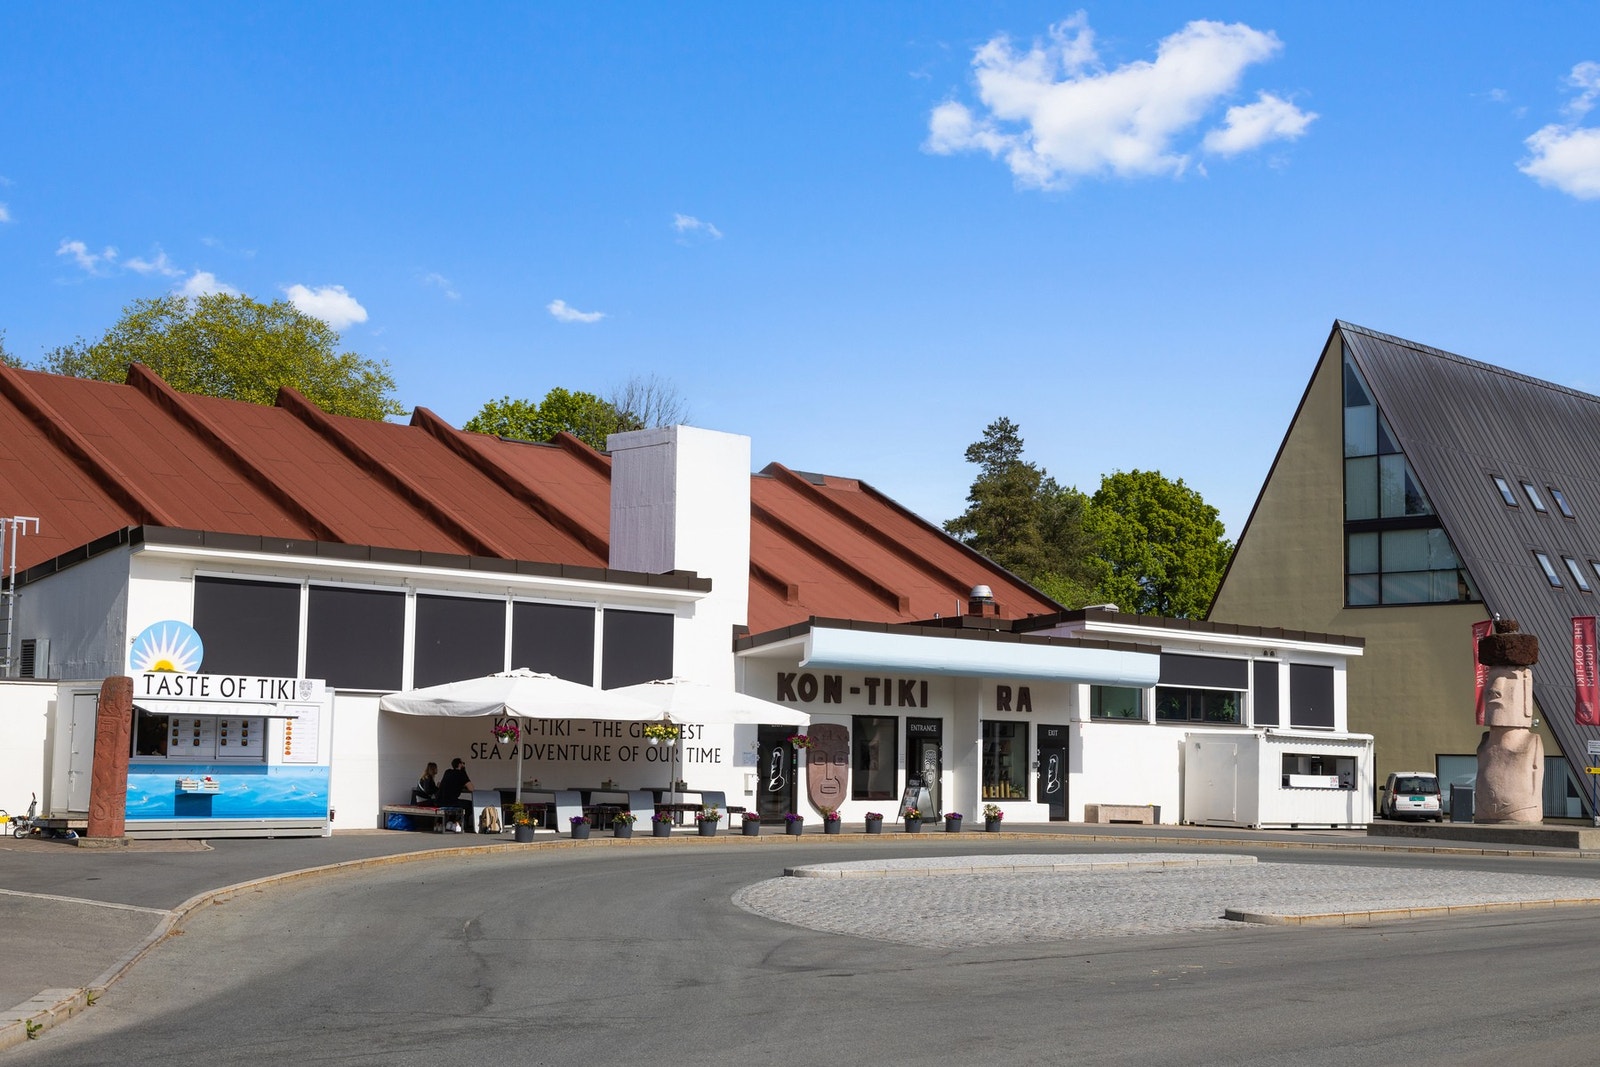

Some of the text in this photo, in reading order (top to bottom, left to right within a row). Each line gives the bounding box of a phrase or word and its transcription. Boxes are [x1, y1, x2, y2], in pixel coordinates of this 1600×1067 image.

[143, 674, 296, 700] TASTE OF TIKI
[776, 672, 928, 708] KON-TIKI
[996, 685, 1032, 712] RA
[592, 721, 622, 738] THE
[910, 724, 937, 732] ENTRANCE
[470, 742, 721, 763] SEA ADVENTURE OF OUR TIME
